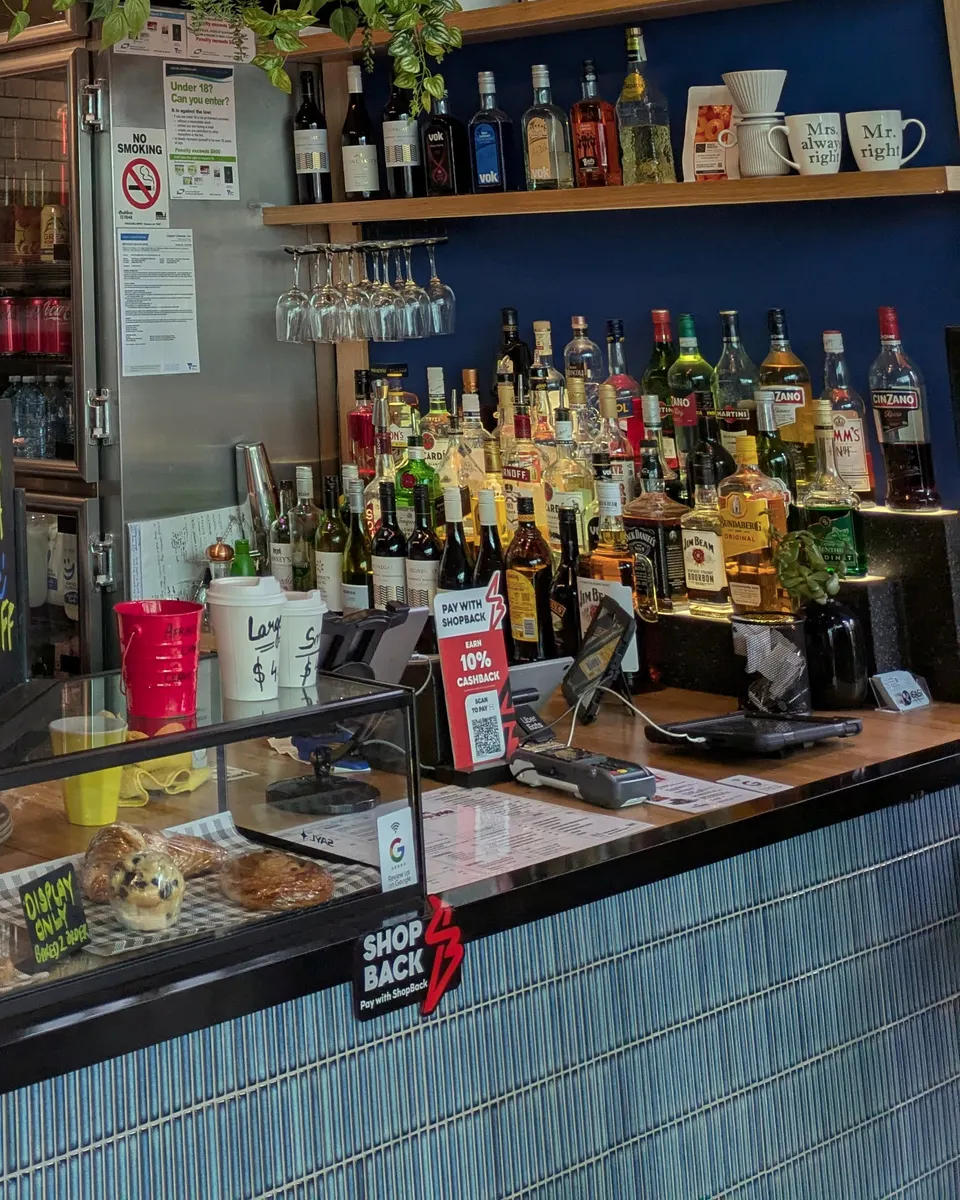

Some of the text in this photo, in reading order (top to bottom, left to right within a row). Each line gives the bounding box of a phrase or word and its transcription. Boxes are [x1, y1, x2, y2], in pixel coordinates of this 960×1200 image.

[170, 81, 213, 94] Under 18?
[171, 93, 229, 106] Can you enter?
[428, 131, 444, 142] vok
[807, 123, 838, 136] Mrs.
[862, 124, 896, 140] Mr.
[132, 133, 147, 143] NO
[117, 143, 162, 155] SMOKING
[860, 144, 900, 162] right
[808, 150, 840, 167] right
[479, 170, 498, 183] vok
[531, 166, 550, 179] vok
[774, 391, 801, 402] ZANO
[872, 393, 915, 405] CINZANO
[834, 427, 860, 442] MM'S
[503, 469, 527, 479] RNOFF
[683, 536, 714, 554] JIM BEAM
[724, 534, 755, 542] ORIGINAL
[688, 574, 714, 583] BOURBON
[579, 589, 592, 607] JIM
[442, 599, 483, 614] PAY WITH
[442, 612, 486, 628] SHOPBACK
[248, 615, 281, 648] Larg
[465, 639, 482, 649] EARN
[460, 650, 492, 672] 10%
[253, 656, 265, 691] $
[457, 671, 500, 687] CASHBACK
[475, 697, 488, 705] SCAN
[479, 705, 488, 713] PAY
[395, 876, 411, 887] Google
[24, 870, 75, 920] DISPLAY
[35, 902, 68, 941] ONLY
[363, 920, 423, 961] SHOP
[364, 948, 424, 992] BACK
[360, 979, 428, 1010] Pay with ShopBack
